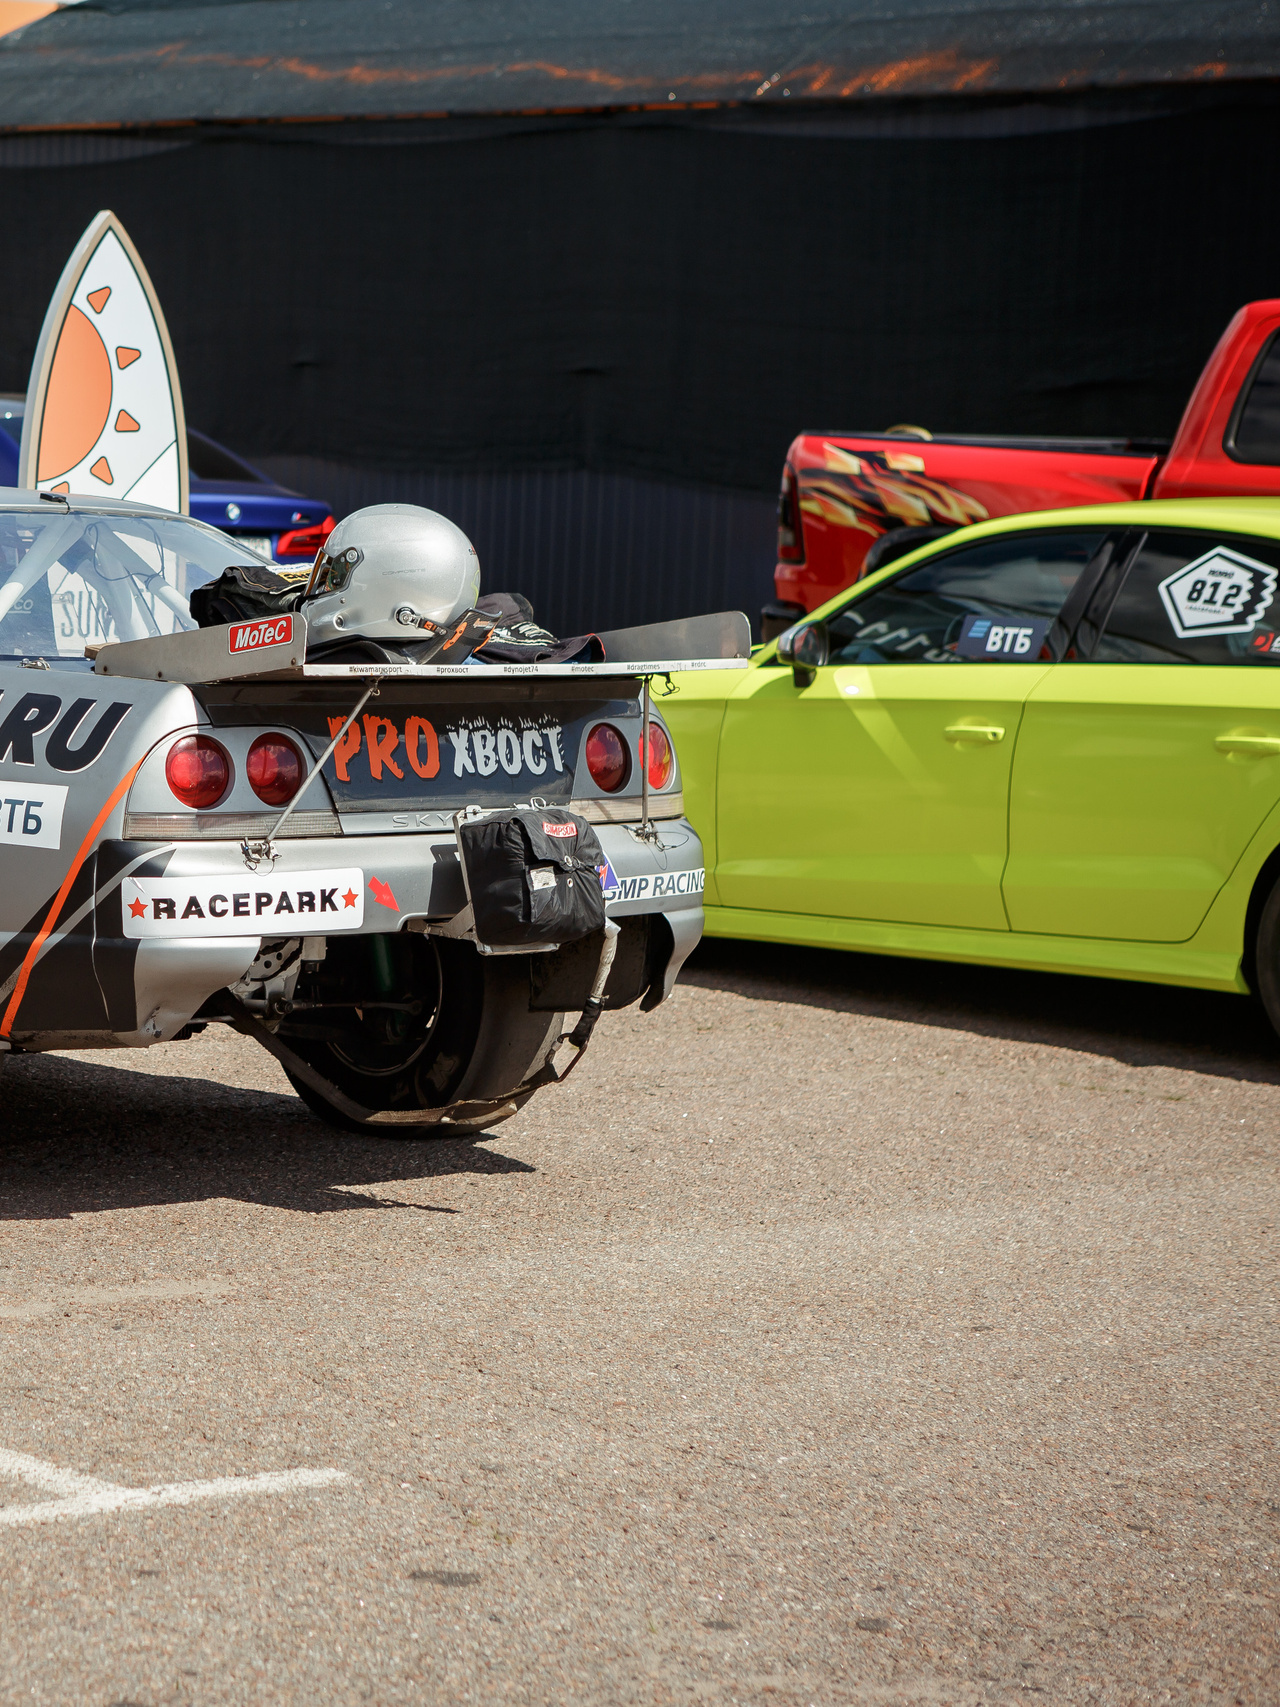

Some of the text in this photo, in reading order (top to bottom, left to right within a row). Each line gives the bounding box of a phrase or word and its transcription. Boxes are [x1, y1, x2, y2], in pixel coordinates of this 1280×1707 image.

[1186, 579, 1243, 608] 812
[234, 620, 287, 649] MoTeC
[985, 625, 1034, 654] ВТБ
[503, 665, 539, 674] #dynojet74
[626, 663, 660, 671] #dragtimes
[327, 713, 440, 782] PRO
[545, 823, 575, 836] SIMPSON
[151, 888, 339, 920] RACEPARK
